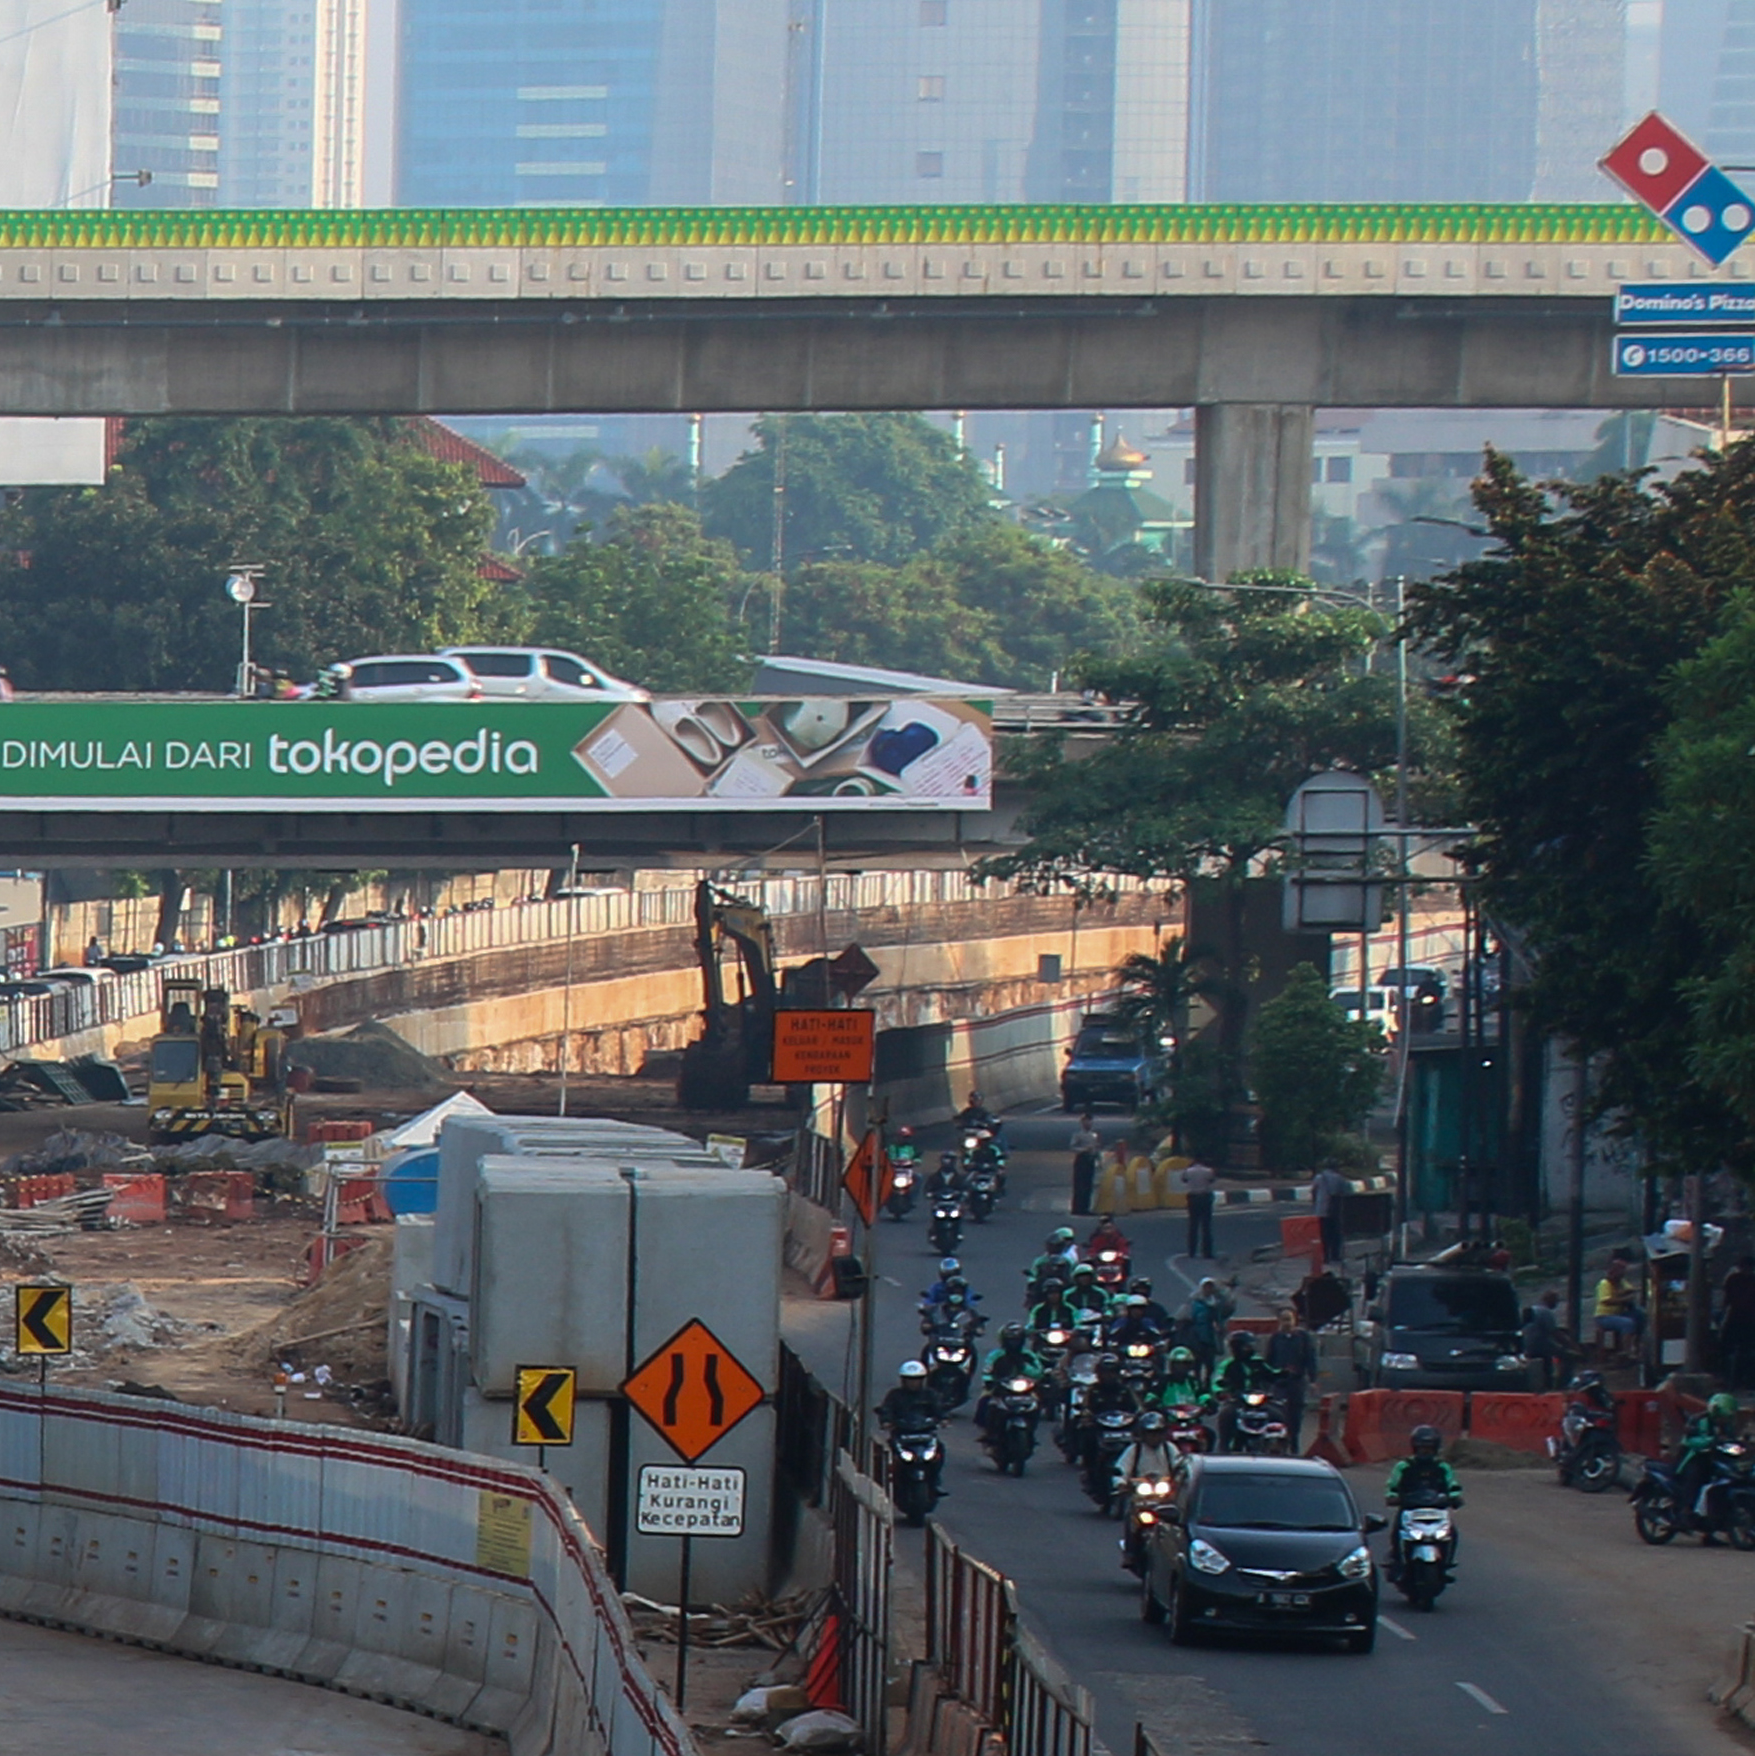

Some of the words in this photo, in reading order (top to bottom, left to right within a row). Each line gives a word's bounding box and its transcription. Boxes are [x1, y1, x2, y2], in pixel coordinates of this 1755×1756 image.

[1619, 293, 1706, 310] Domino's
[2, 740, 152, 769] DIMULAI
[166, 741, 250, 769] DARI
[269, 727, 538, 787] tokopedia
[791, 1018, 858, 1031] HATI-HATI
[647, 1474, 738, 1491] Hati-Hati
[650, 1494, 729, 1514] Kurangi
[640, 1511, 741, 1528] Kecepatan
